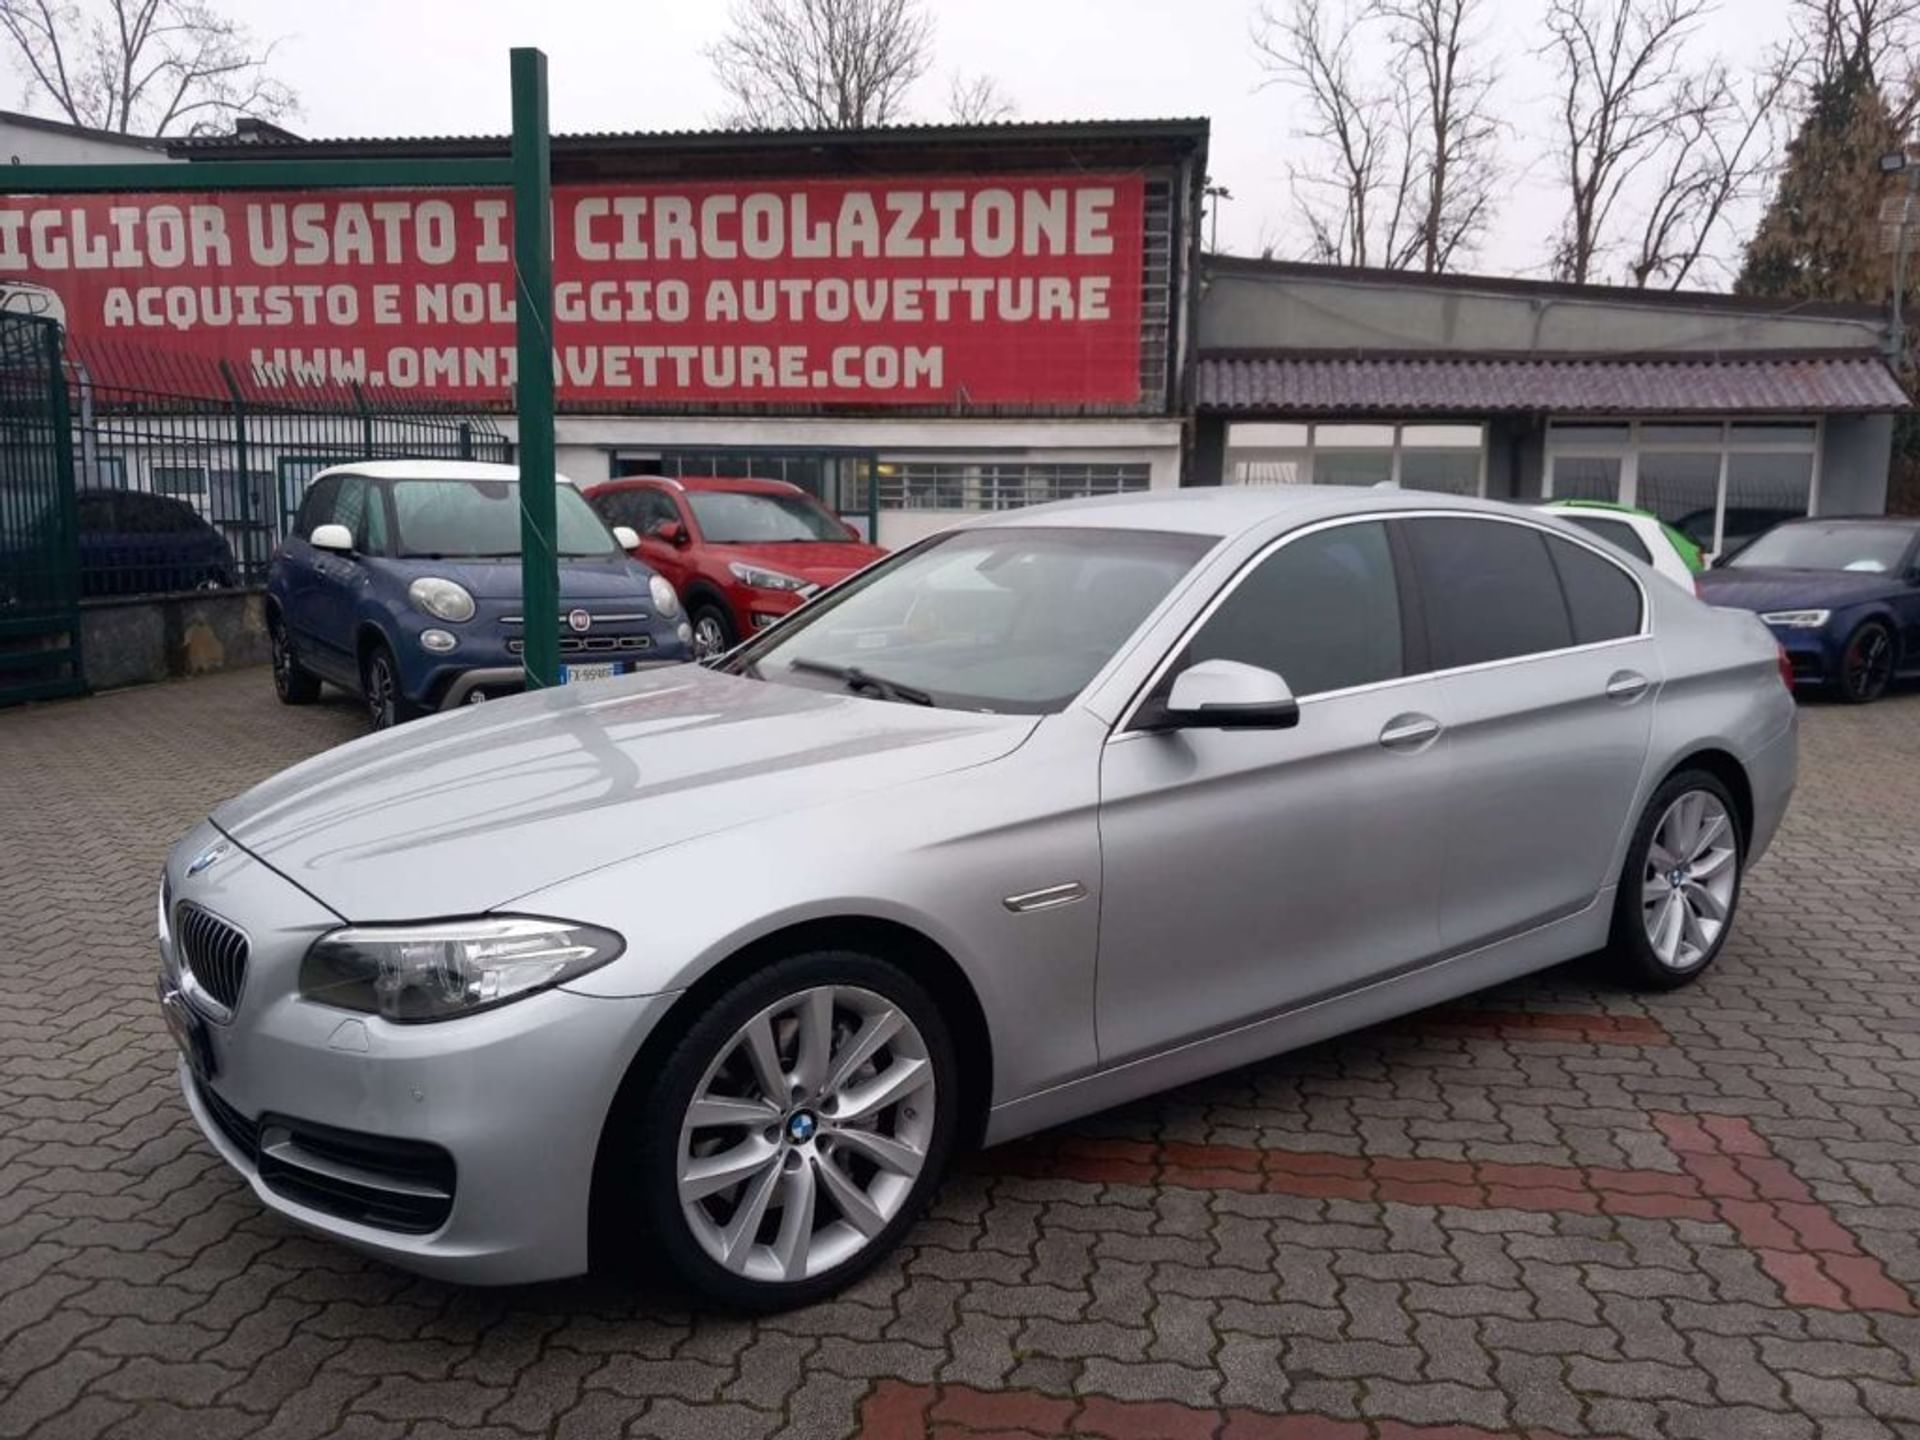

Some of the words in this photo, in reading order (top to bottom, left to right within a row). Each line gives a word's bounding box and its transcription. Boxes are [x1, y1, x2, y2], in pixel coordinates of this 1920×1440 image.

[248, 201, 457, 266] USATO
[574, 188, 1115, 261] CIRCOLAZIONE
[104, 284, 359, 330] ACQUISTO
[374, 285, 402, 324] E
[416, 280, 690, 324] NOLGGIO
[705, 276, 1112, 322] AUTOVETTURE
